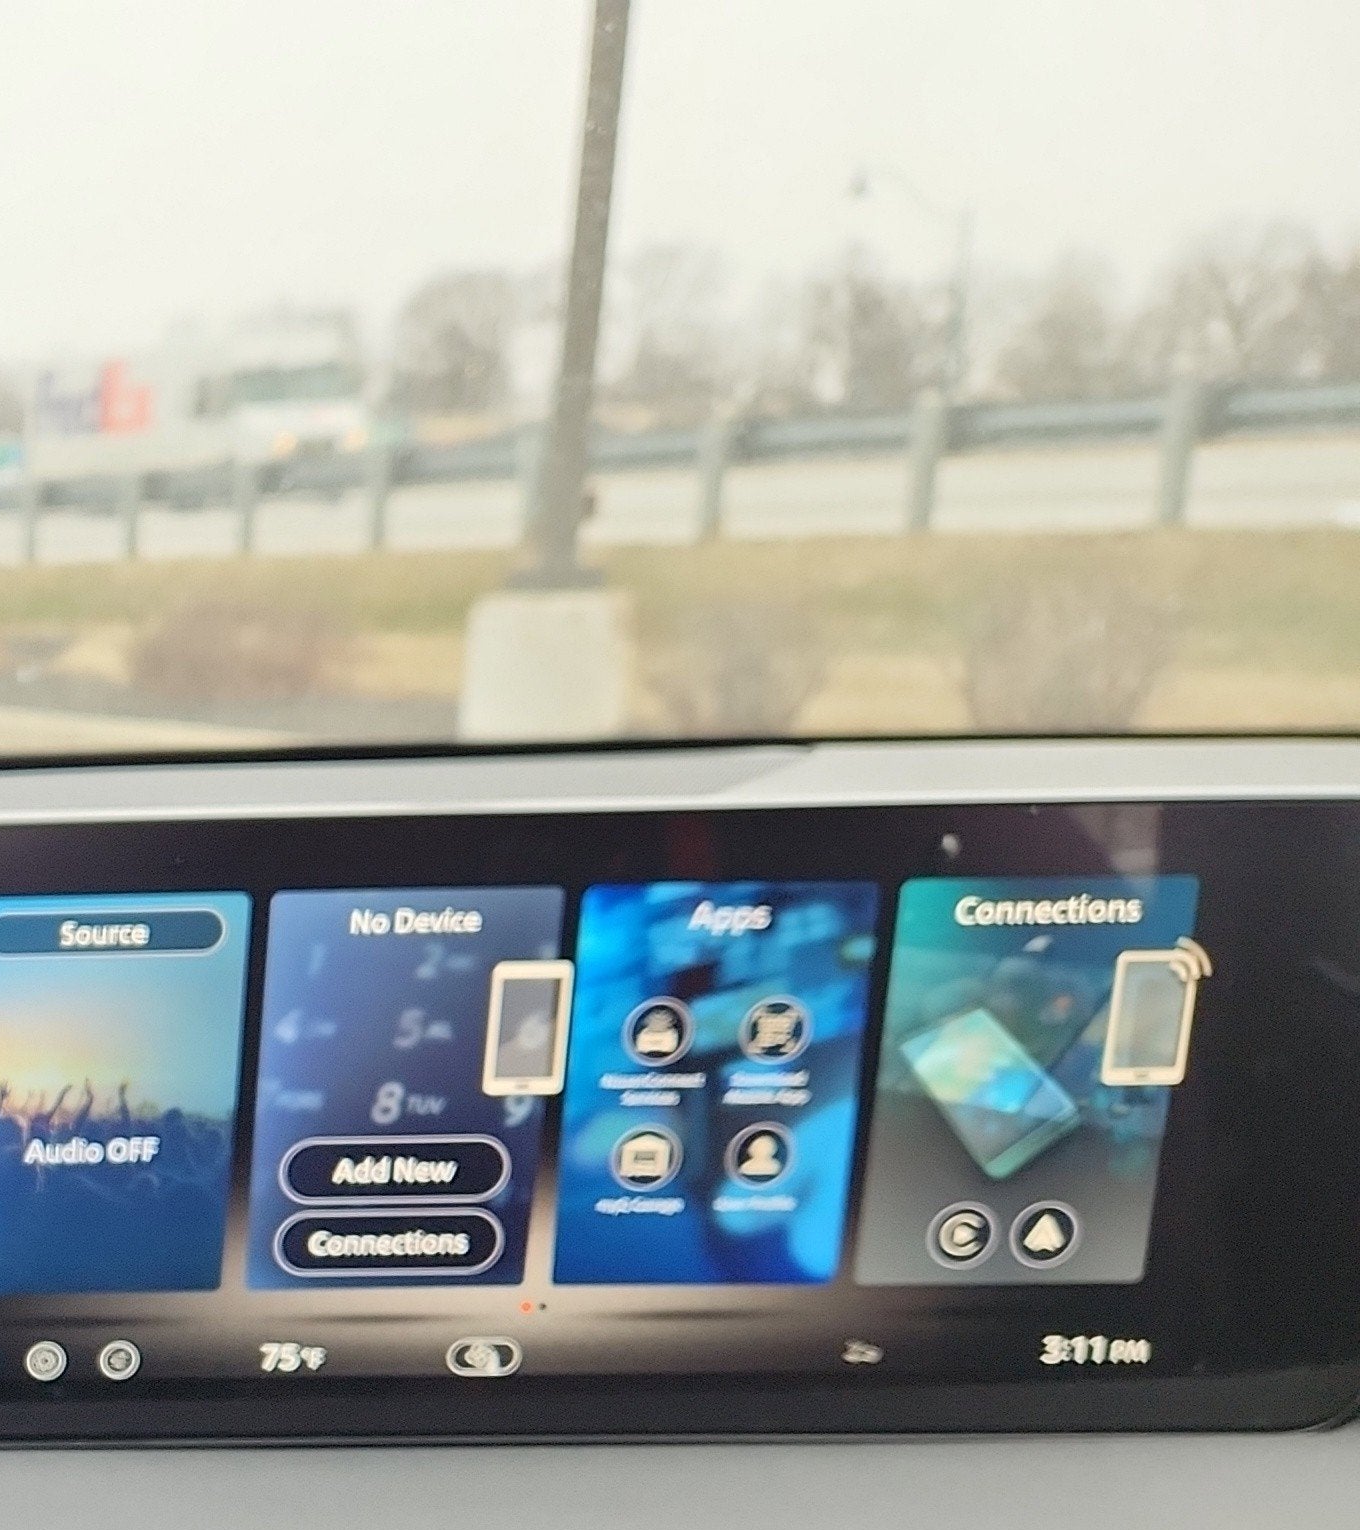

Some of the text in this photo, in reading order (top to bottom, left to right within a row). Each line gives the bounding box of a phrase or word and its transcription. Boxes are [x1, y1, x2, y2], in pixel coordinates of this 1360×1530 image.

[349, 906, 483, 935] No Device
[689, 899, 773, 935] Apps
[955, 895, 1142, 926] Connections
[59, 920, 151, 947] Source
[370, 1081, 406, 1125] 8
[23, 1136, 160, 1164] Audio OFF
[332, 1155, 458, 1184] Add New
[307, 1229, 471, 1257] Connections
